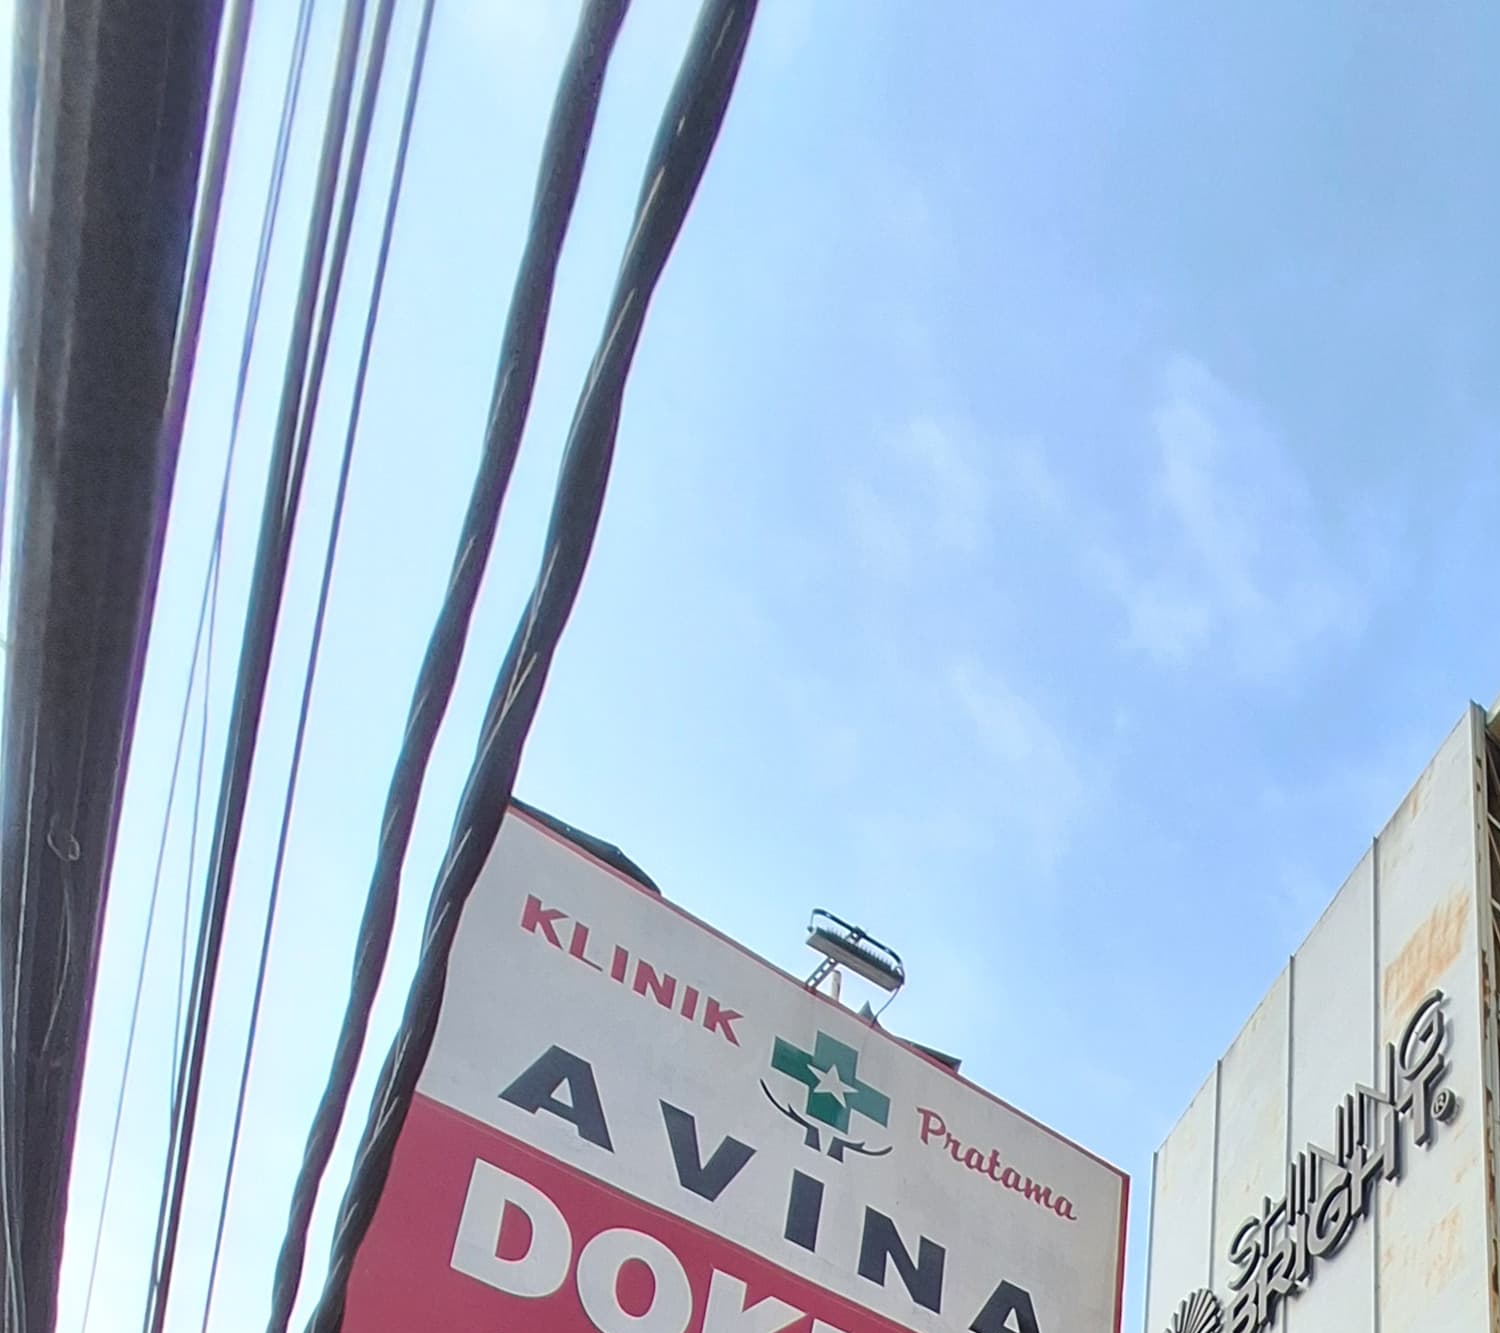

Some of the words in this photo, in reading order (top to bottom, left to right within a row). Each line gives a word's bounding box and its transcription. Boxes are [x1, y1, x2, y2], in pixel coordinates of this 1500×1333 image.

[521, 895, 744, 1046] KLINIK
[916, 1107, 1078, 1222] Pratama
[1228, 988, 1445, 1291] SHINING
